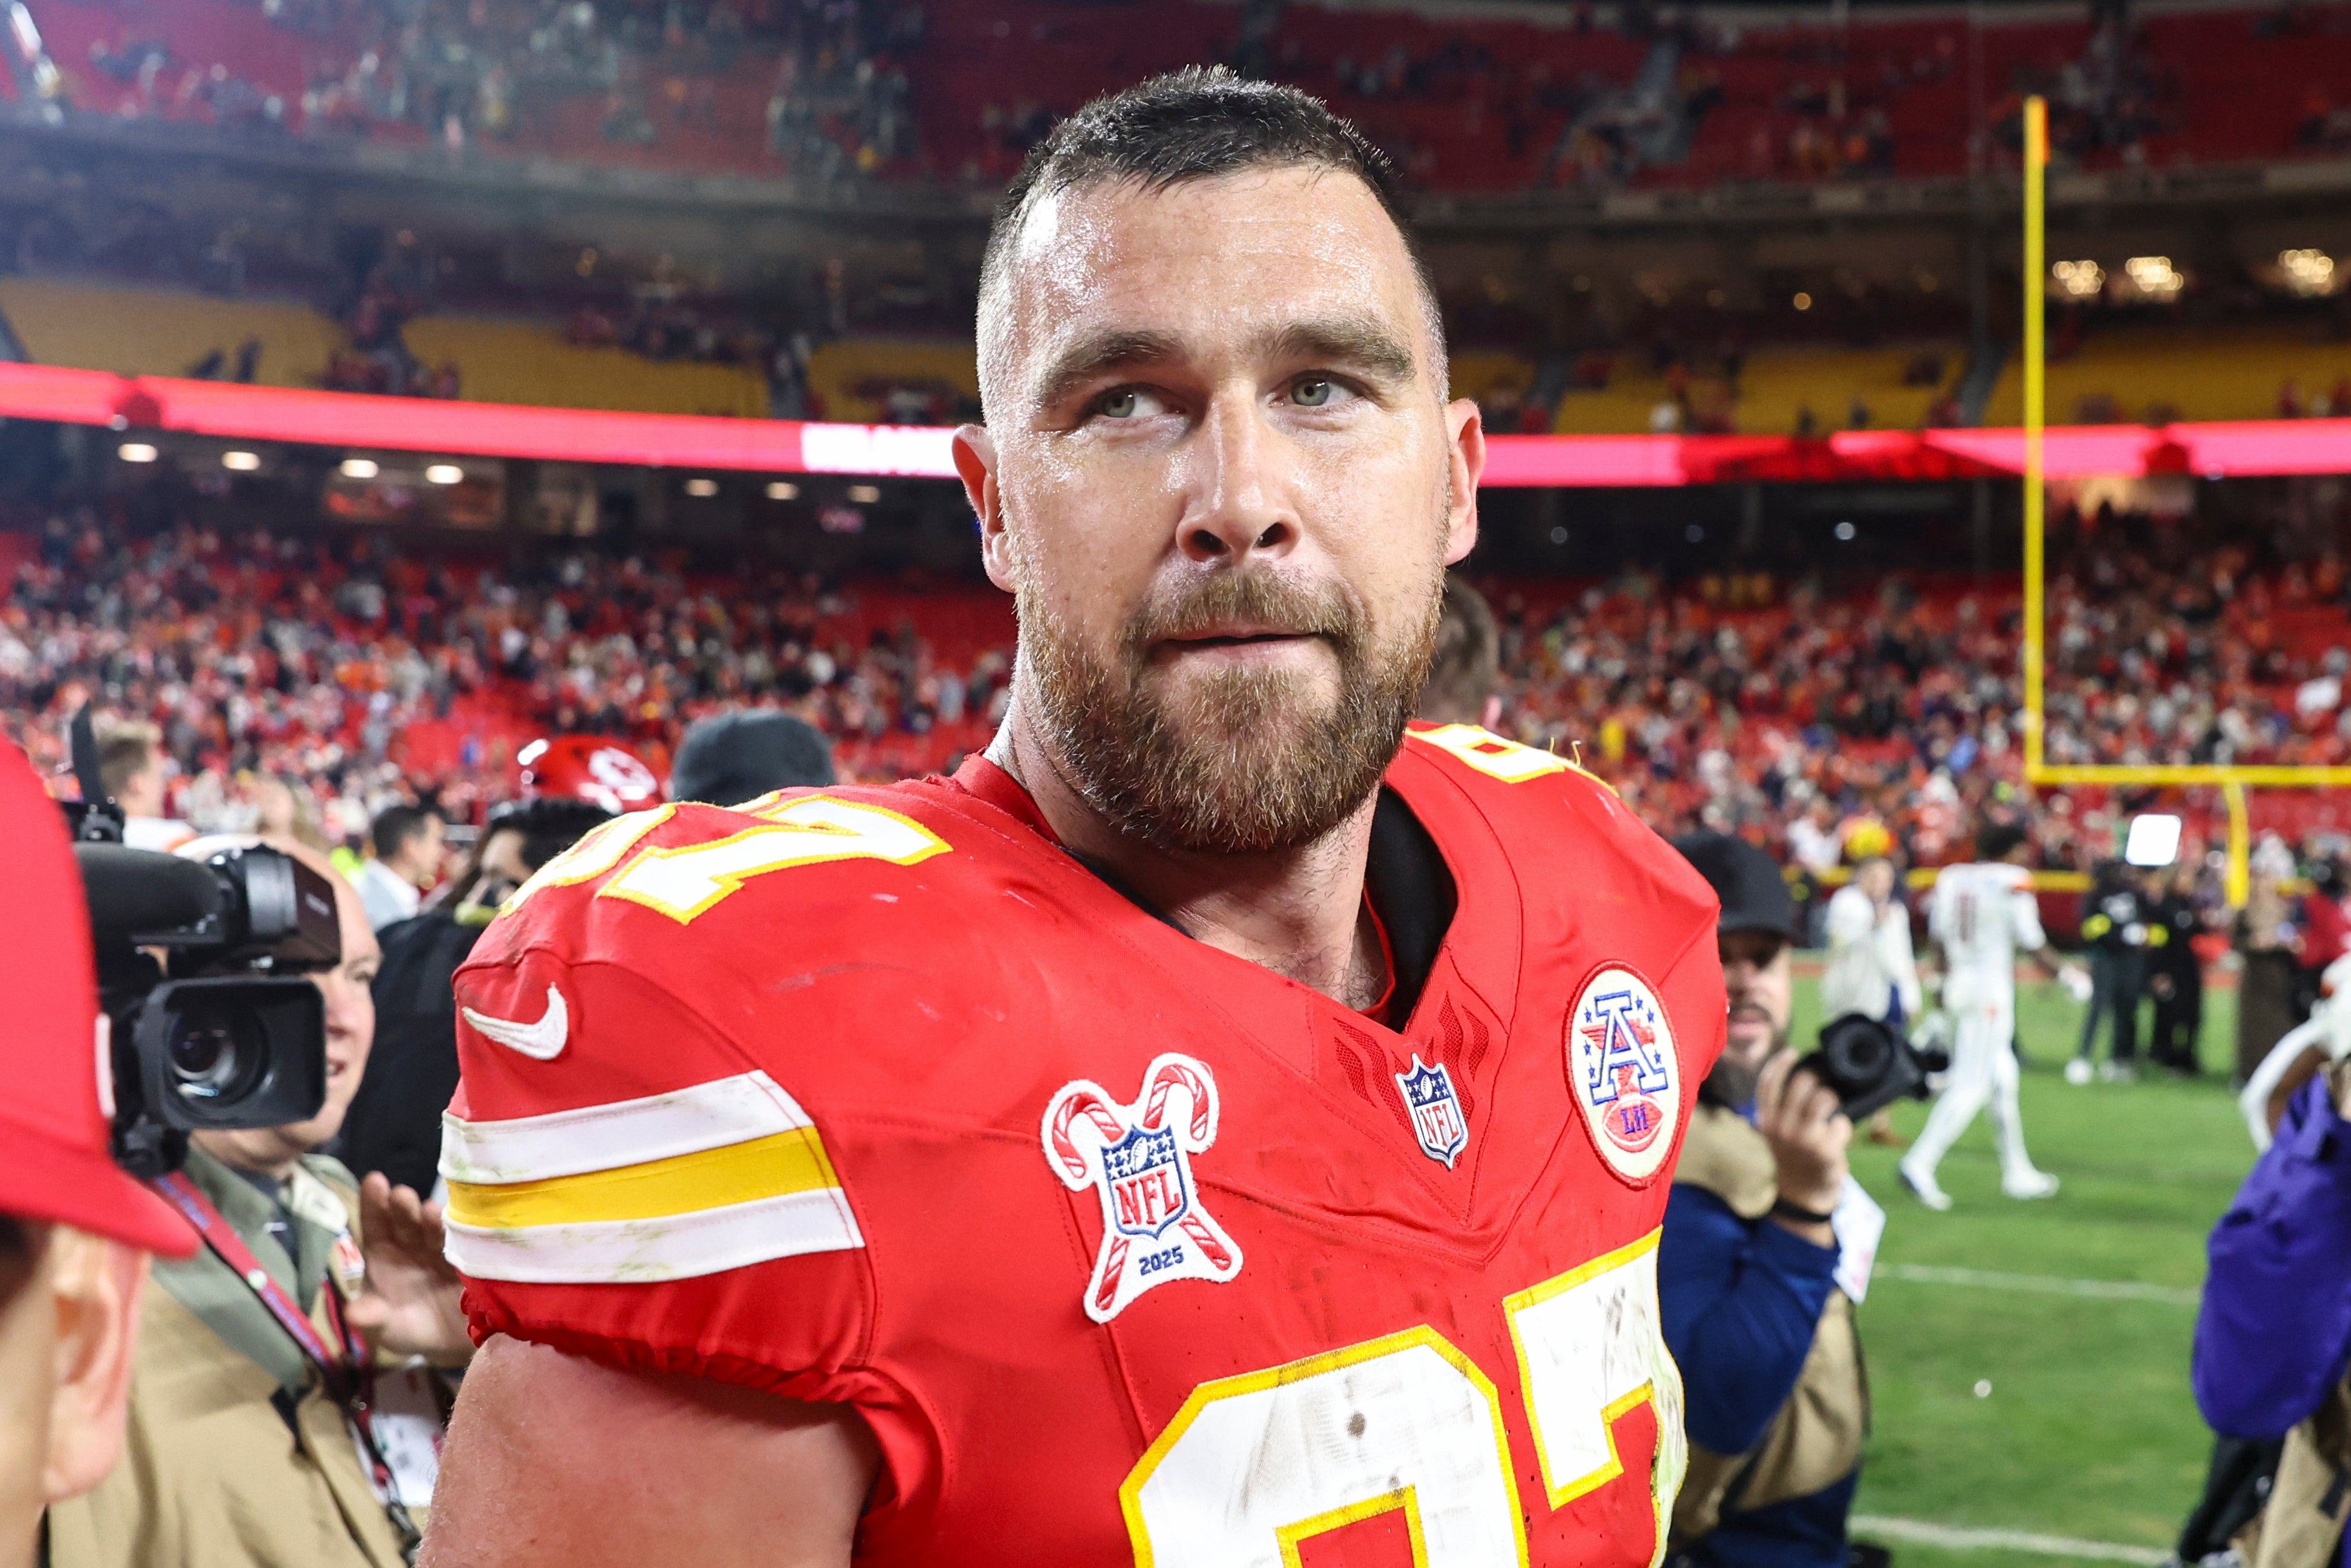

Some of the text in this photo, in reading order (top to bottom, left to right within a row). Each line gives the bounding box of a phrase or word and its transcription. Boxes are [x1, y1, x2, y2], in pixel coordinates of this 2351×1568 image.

[1589, 991, 1667, 1105] A
[1419, 1103, 1458, 1146] NFL
[1621, 1105, 1648, 1134] LH
[1115, 1169, 1180, 1225] NFL
[1138, 1245, 1184, 1276] 2025
